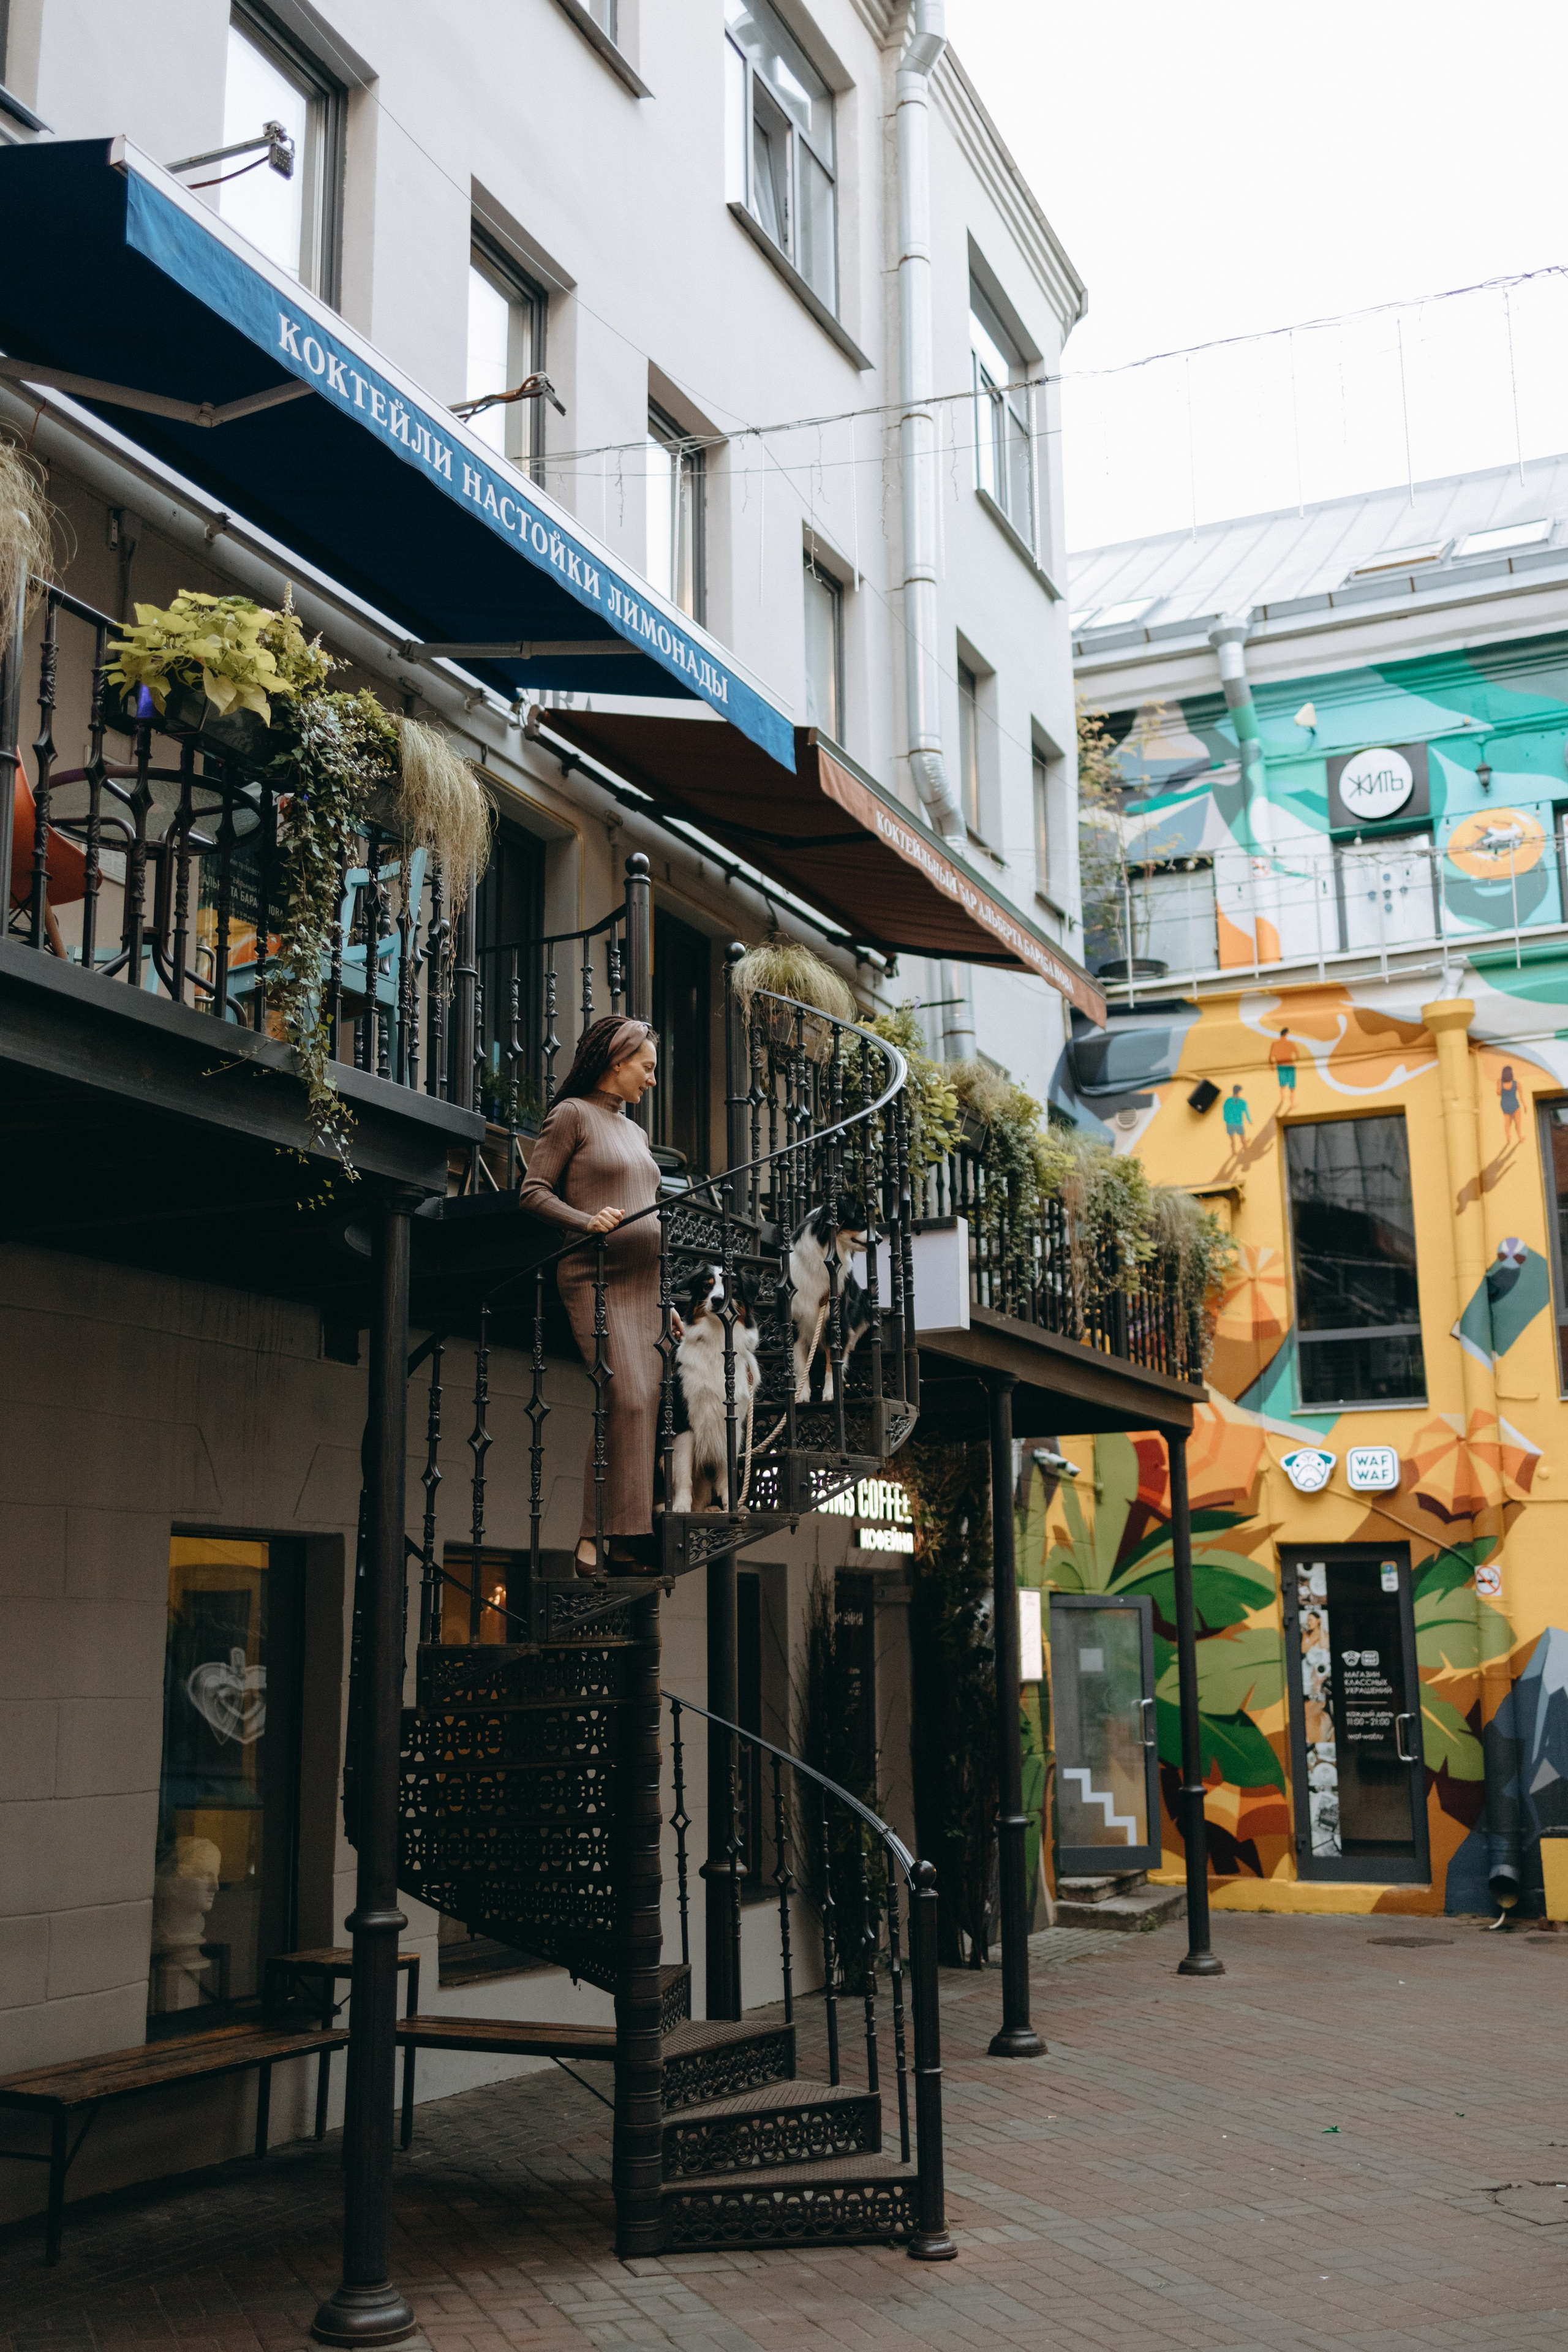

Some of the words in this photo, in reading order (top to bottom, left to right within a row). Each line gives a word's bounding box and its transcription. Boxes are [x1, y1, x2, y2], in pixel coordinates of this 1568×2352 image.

[279, 312, 453, 481] КОКТЕЙЛИ
[462, 462, 601, 600] НАСТОЙКИ
[608, 584, 729, 704] ЛИМОНАДЫ
[1348, 769, 1404, 798] ЖИТЬ
[876, 810, 958, 894] КОКТЕЙЛЬНЫЙ
[959, 882, 978, 910] БАР
[979, 902, 1023, 951] АЛЬБЕРТА
[1355, 1455, 1389, 1466] WAF
[1357, 1469, 1389, 1480] WAF
[860, 1526, 914, 1555] КОФЕЙНЯ
